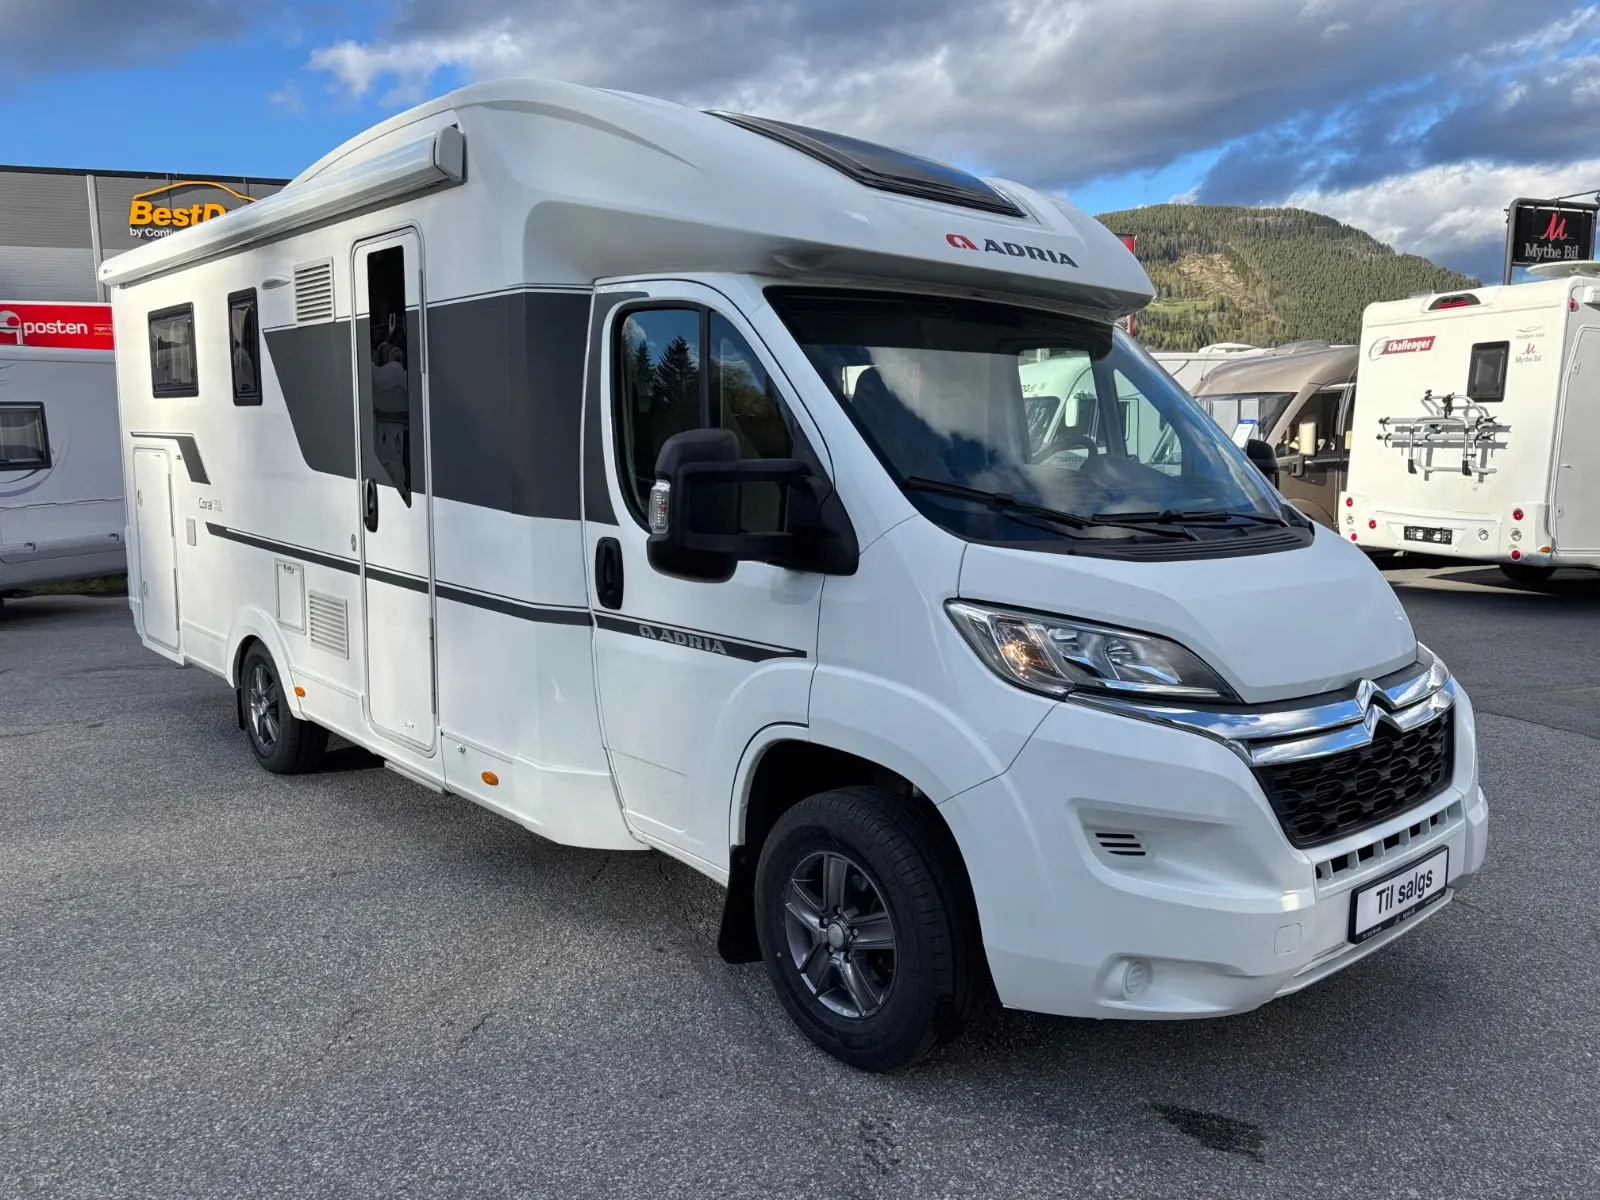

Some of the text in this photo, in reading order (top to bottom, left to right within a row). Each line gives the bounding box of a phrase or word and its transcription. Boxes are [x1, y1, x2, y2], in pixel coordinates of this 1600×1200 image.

[129, 200, 226, 227] BestD
[130, 228, 178, 238] by Conti
[984, 238, 1079, 268] ADRIA
[1524, 243, 1579, 262] Mythe Bil
[24, 319, 88, 336] posten
[1388, 340, 1431, 352] Challenger
[199, 497, 212, 511] Coral
[660, 629, 727, 655] ADRIA
[1376, 884, 1394, 914] Til
[1397, 869, 1433, 904] salgs
